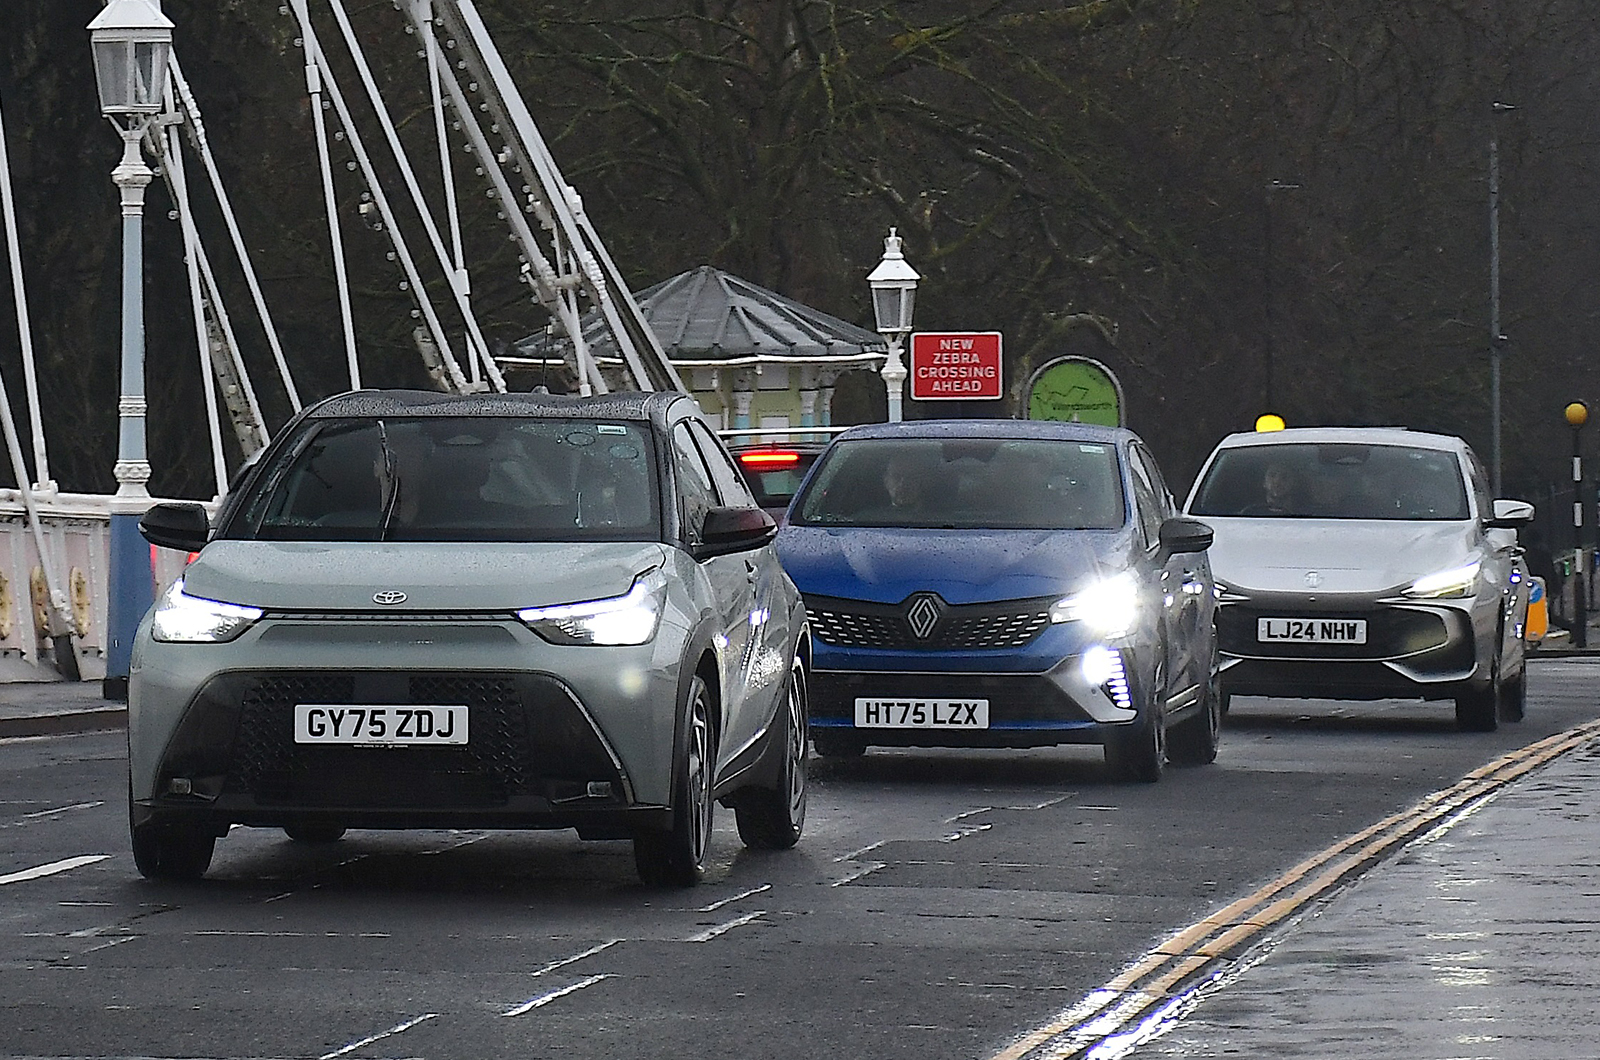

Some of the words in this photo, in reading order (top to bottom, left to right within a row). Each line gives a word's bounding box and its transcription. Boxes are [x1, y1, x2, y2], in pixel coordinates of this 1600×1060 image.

[939, 339, 974, 351] NEW
[932, 353, 980, 365] ZEBRA
[917, 366, 996, 379] CROSSING
[931, 380, 982, 392] AHEAD
[1267, 621, 1315, 639] LJ24
[865, 702, 926, 724] HT75
[932, 703, 978, 725] LZX
[308, 709, 387, 738] GY75
[395, 709, 454, 738] ZDJ
